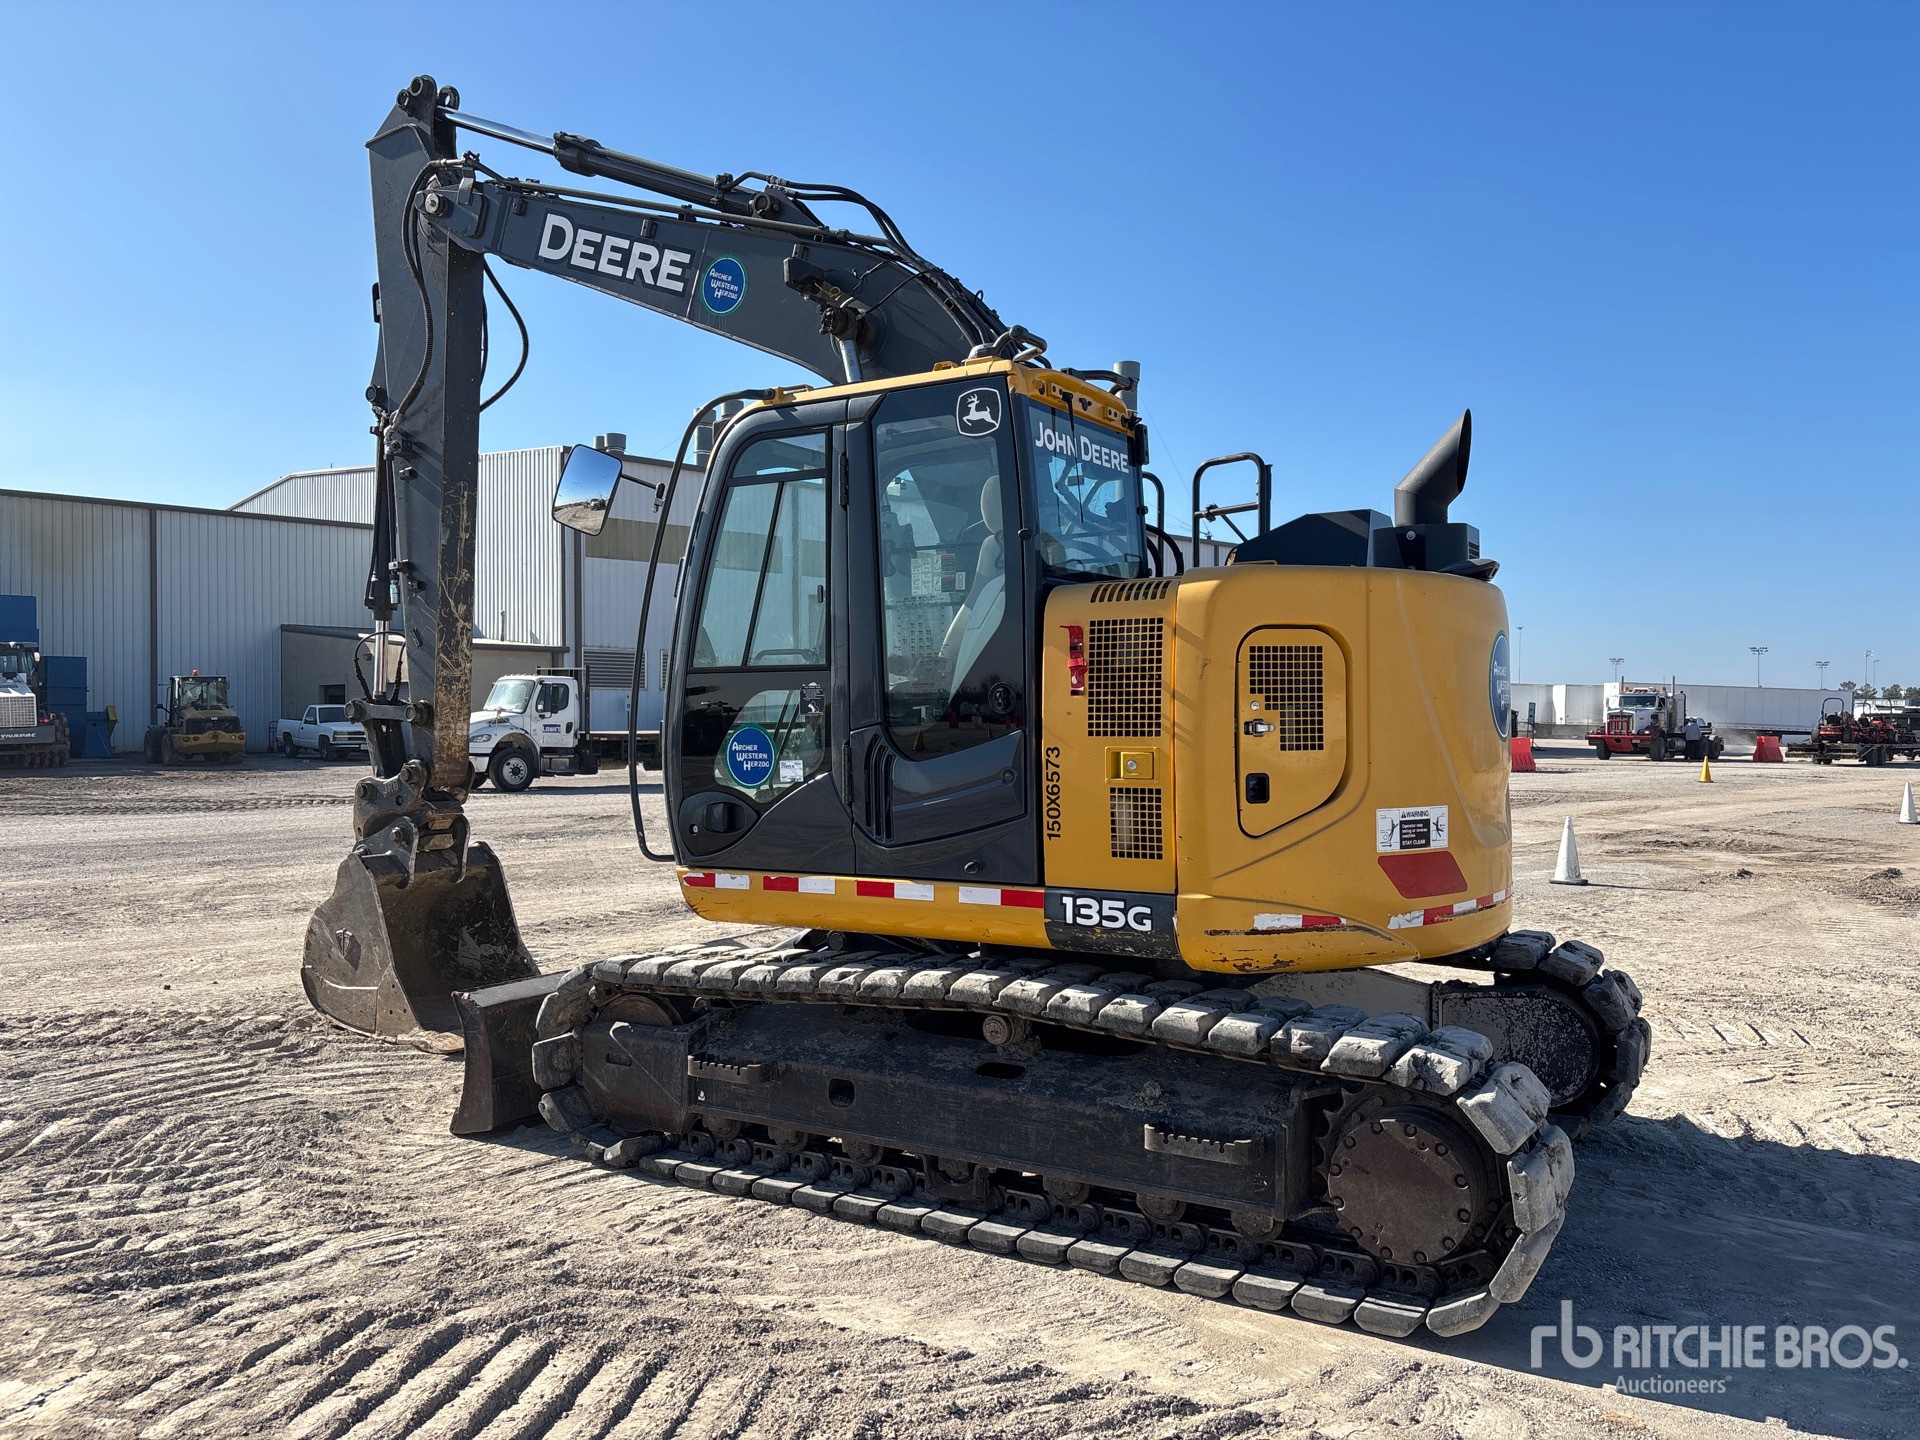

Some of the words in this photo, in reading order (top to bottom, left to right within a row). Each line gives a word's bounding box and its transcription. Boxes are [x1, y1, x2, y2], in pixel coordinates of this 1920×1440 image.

[538, 213, 692, 292] DEERE
[709, 268, 732, 282] ARCHER
[710, 279, 739, 292] WESTERN
[714, 288, 738, 299] HERZOG
[1035, 421, 1078, 456] JOHN
[1080, 435, 1130, 474] DEERE
[731, 741, 758, 751] ARCHER
[736, 752, 768, 762] WESTERN
[743, 760, 770, 771] HERZOG
[1045, 746, 1062, 841] 150X6573
[1406, 810, 1429, 818] WARNING
[1062, 896, 1152, 932] 135G
